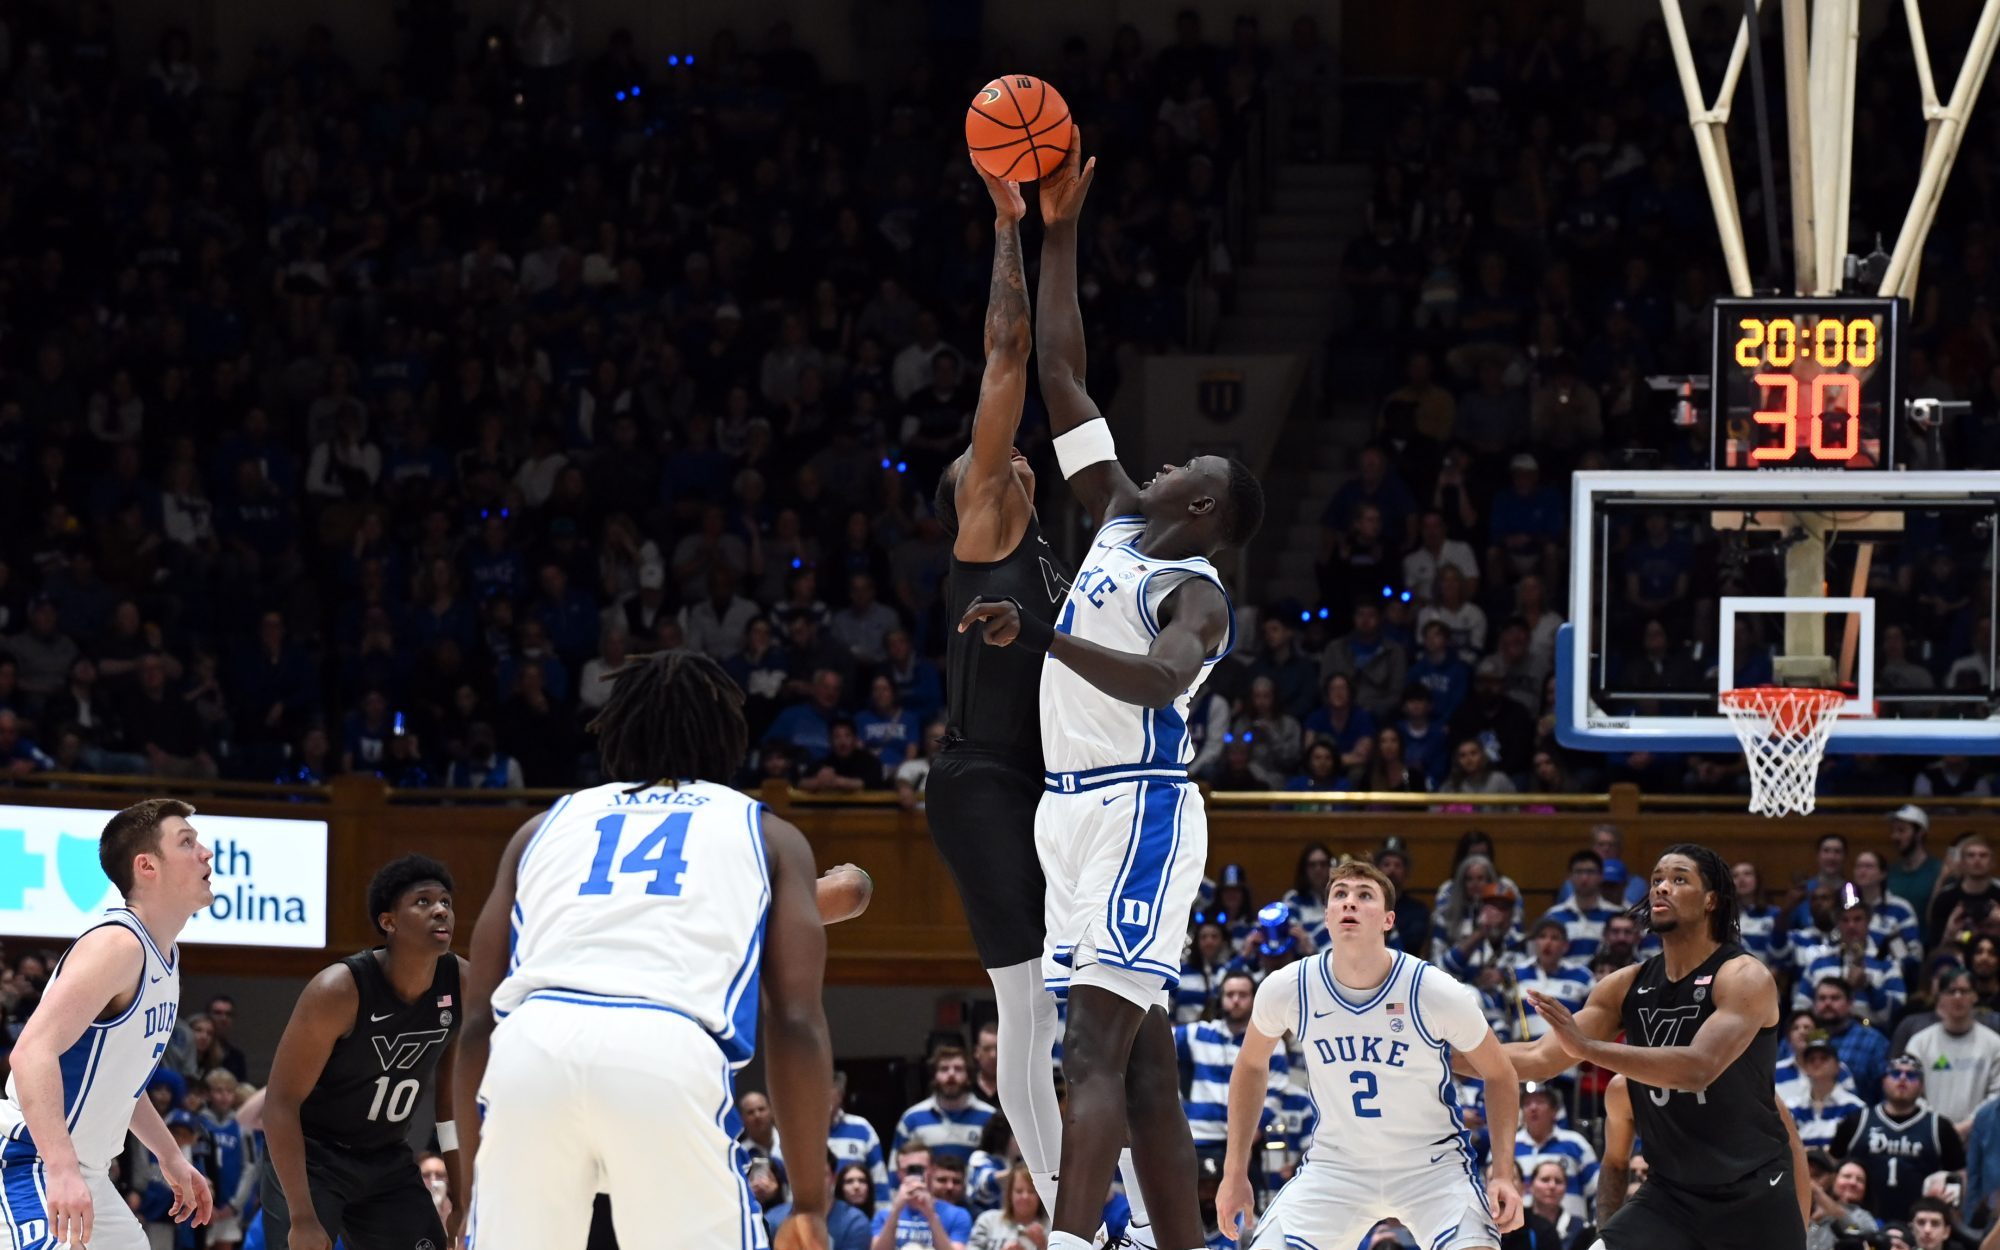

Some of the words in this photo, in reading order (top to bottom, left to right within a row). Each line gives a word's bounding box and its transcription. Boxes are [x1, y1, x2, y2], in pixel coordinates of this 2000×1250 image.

[1735, 319, 1876, 367] 20:00
[1752, 374, 1859, 460] 30
[607, 791, 711, 807] JAMES
[578, 812, 693, 896] 14
[193, 884, 306, 923] olina
[1120, 898, 1150, 927] D
[371, 1028, 449, 1072] VT
[1313, 1035, 1410, 1068] DUKE
[367, 1076, 420, 1123] 10
[1349, 1070, 1382, 1118] 2
[1868, 1131, 1923, 1156] Duke
[1886, 1157, 1898, 1187] 1
[19, 1219, 46, 1247] D
